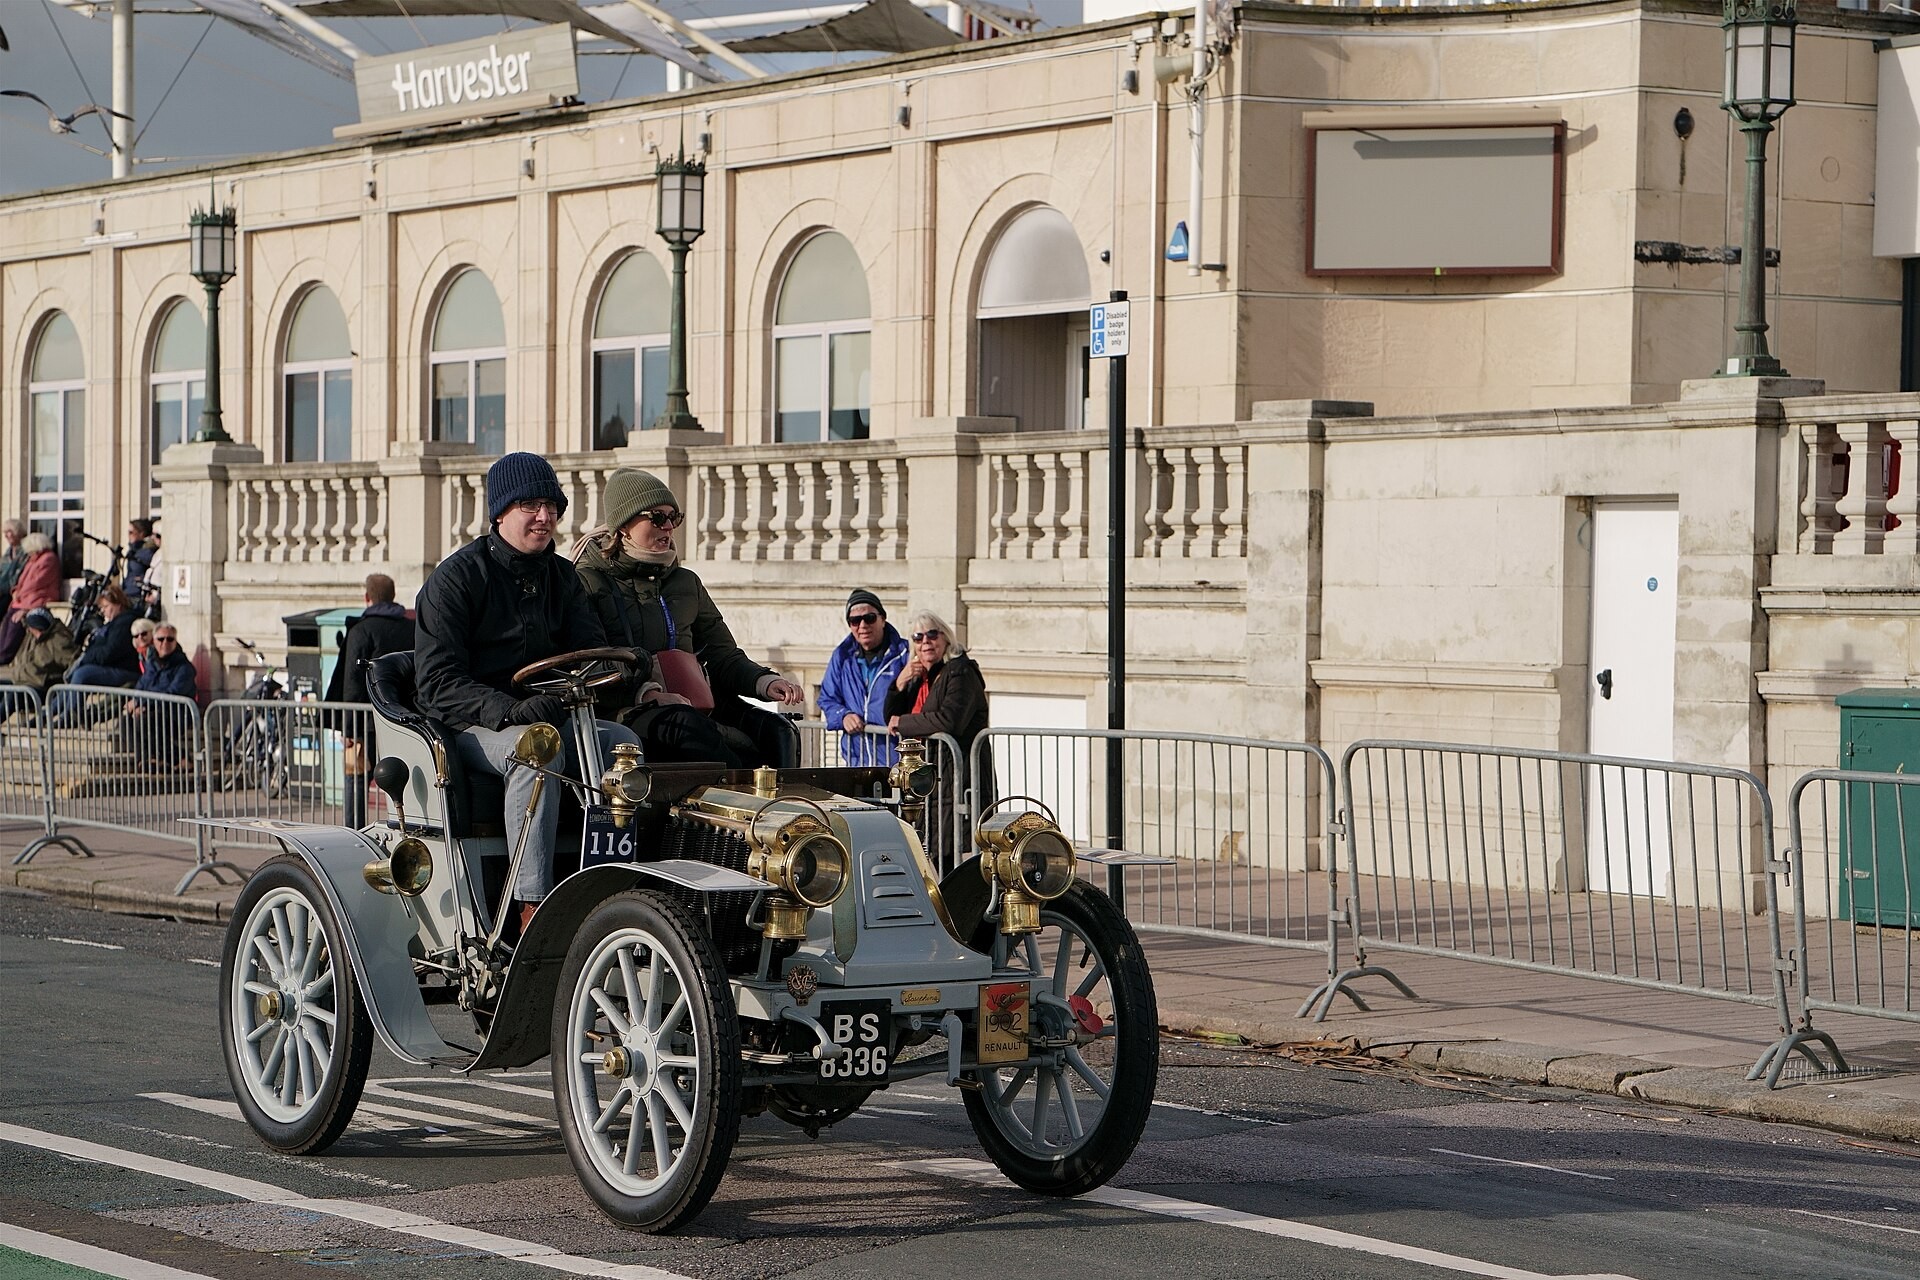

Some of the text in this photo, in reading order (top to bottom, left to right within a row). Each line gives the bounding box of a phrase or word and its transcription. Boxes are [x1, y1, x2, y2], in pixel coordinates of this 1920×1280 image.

[391, 44, 531, 112] Harvester
[1095, 309, 1103, 328] P
[1106, 311, 1127, 320] Disabled
[590, 832, 632, 856] 116
[833, 1013, 880, 1044] BS
[985, 1012, 1023, 1033] 1902
[984, 1041, 1022, 1053] RENAULT
